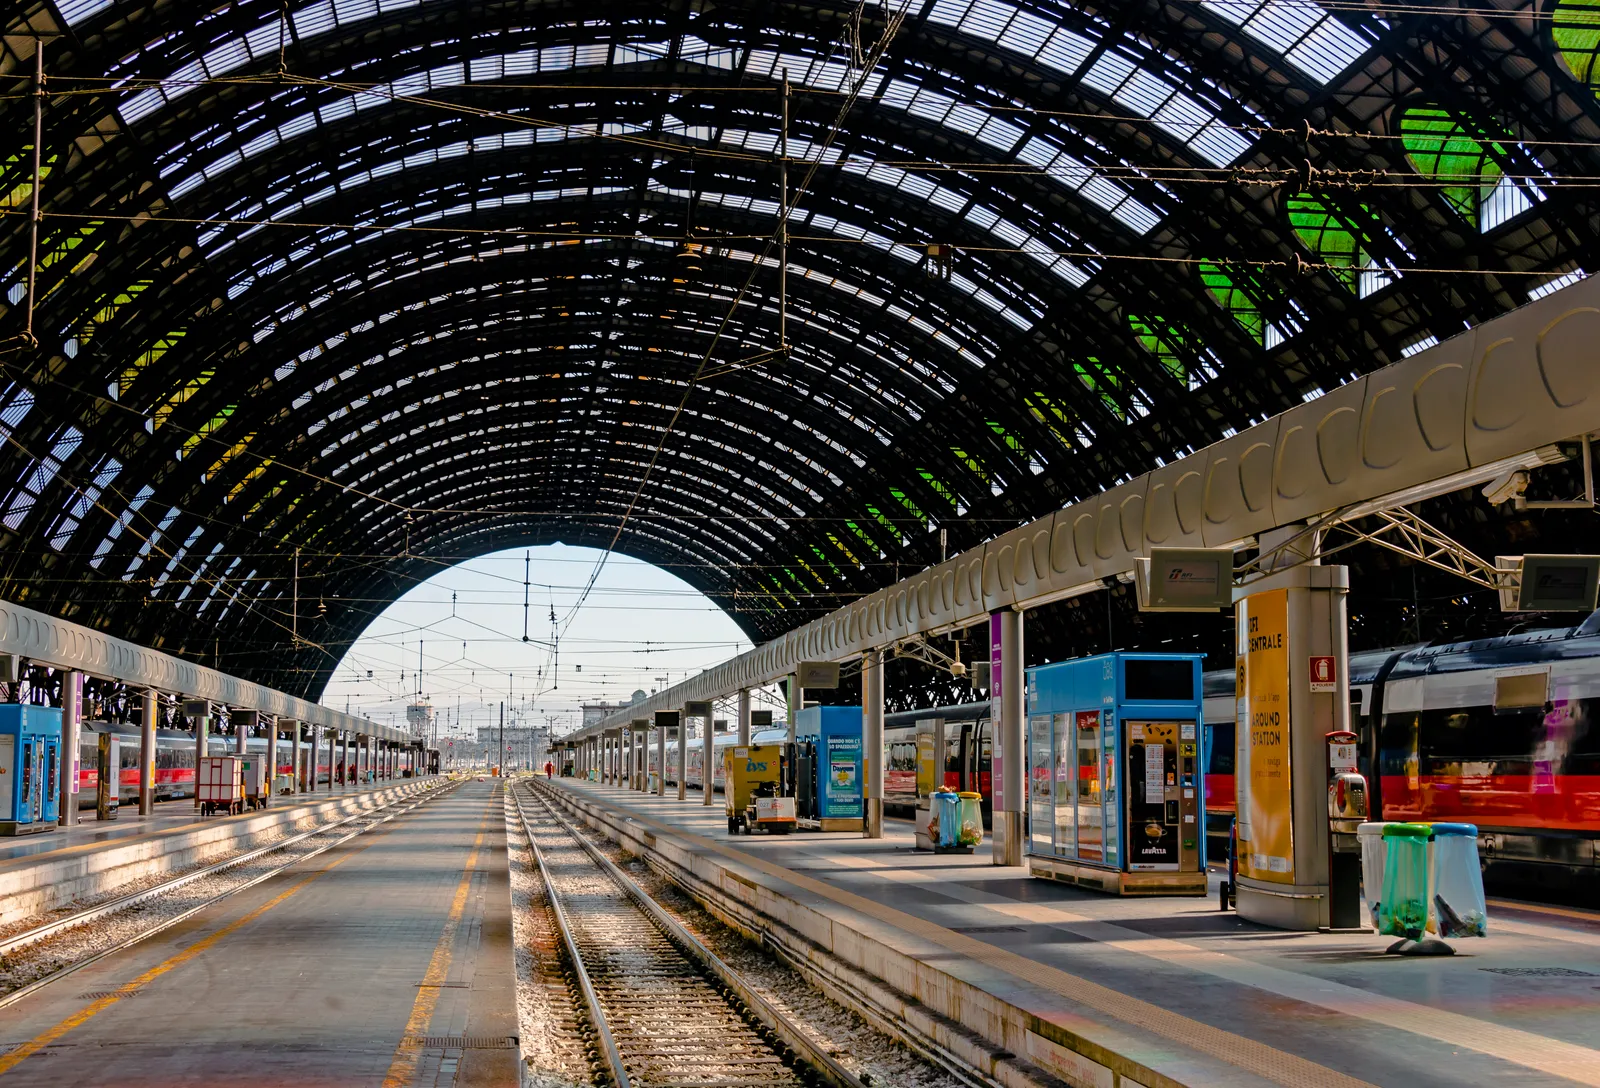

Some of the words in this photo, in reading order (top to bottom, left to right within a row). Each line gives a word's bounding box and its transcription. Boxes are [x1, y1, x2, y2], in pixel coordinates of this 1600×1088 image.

[1248, 616, 1258, 632] IFI
[1252, 712, 1280, 727] AROUND
[1252, 731, 1281, 746] STATION
